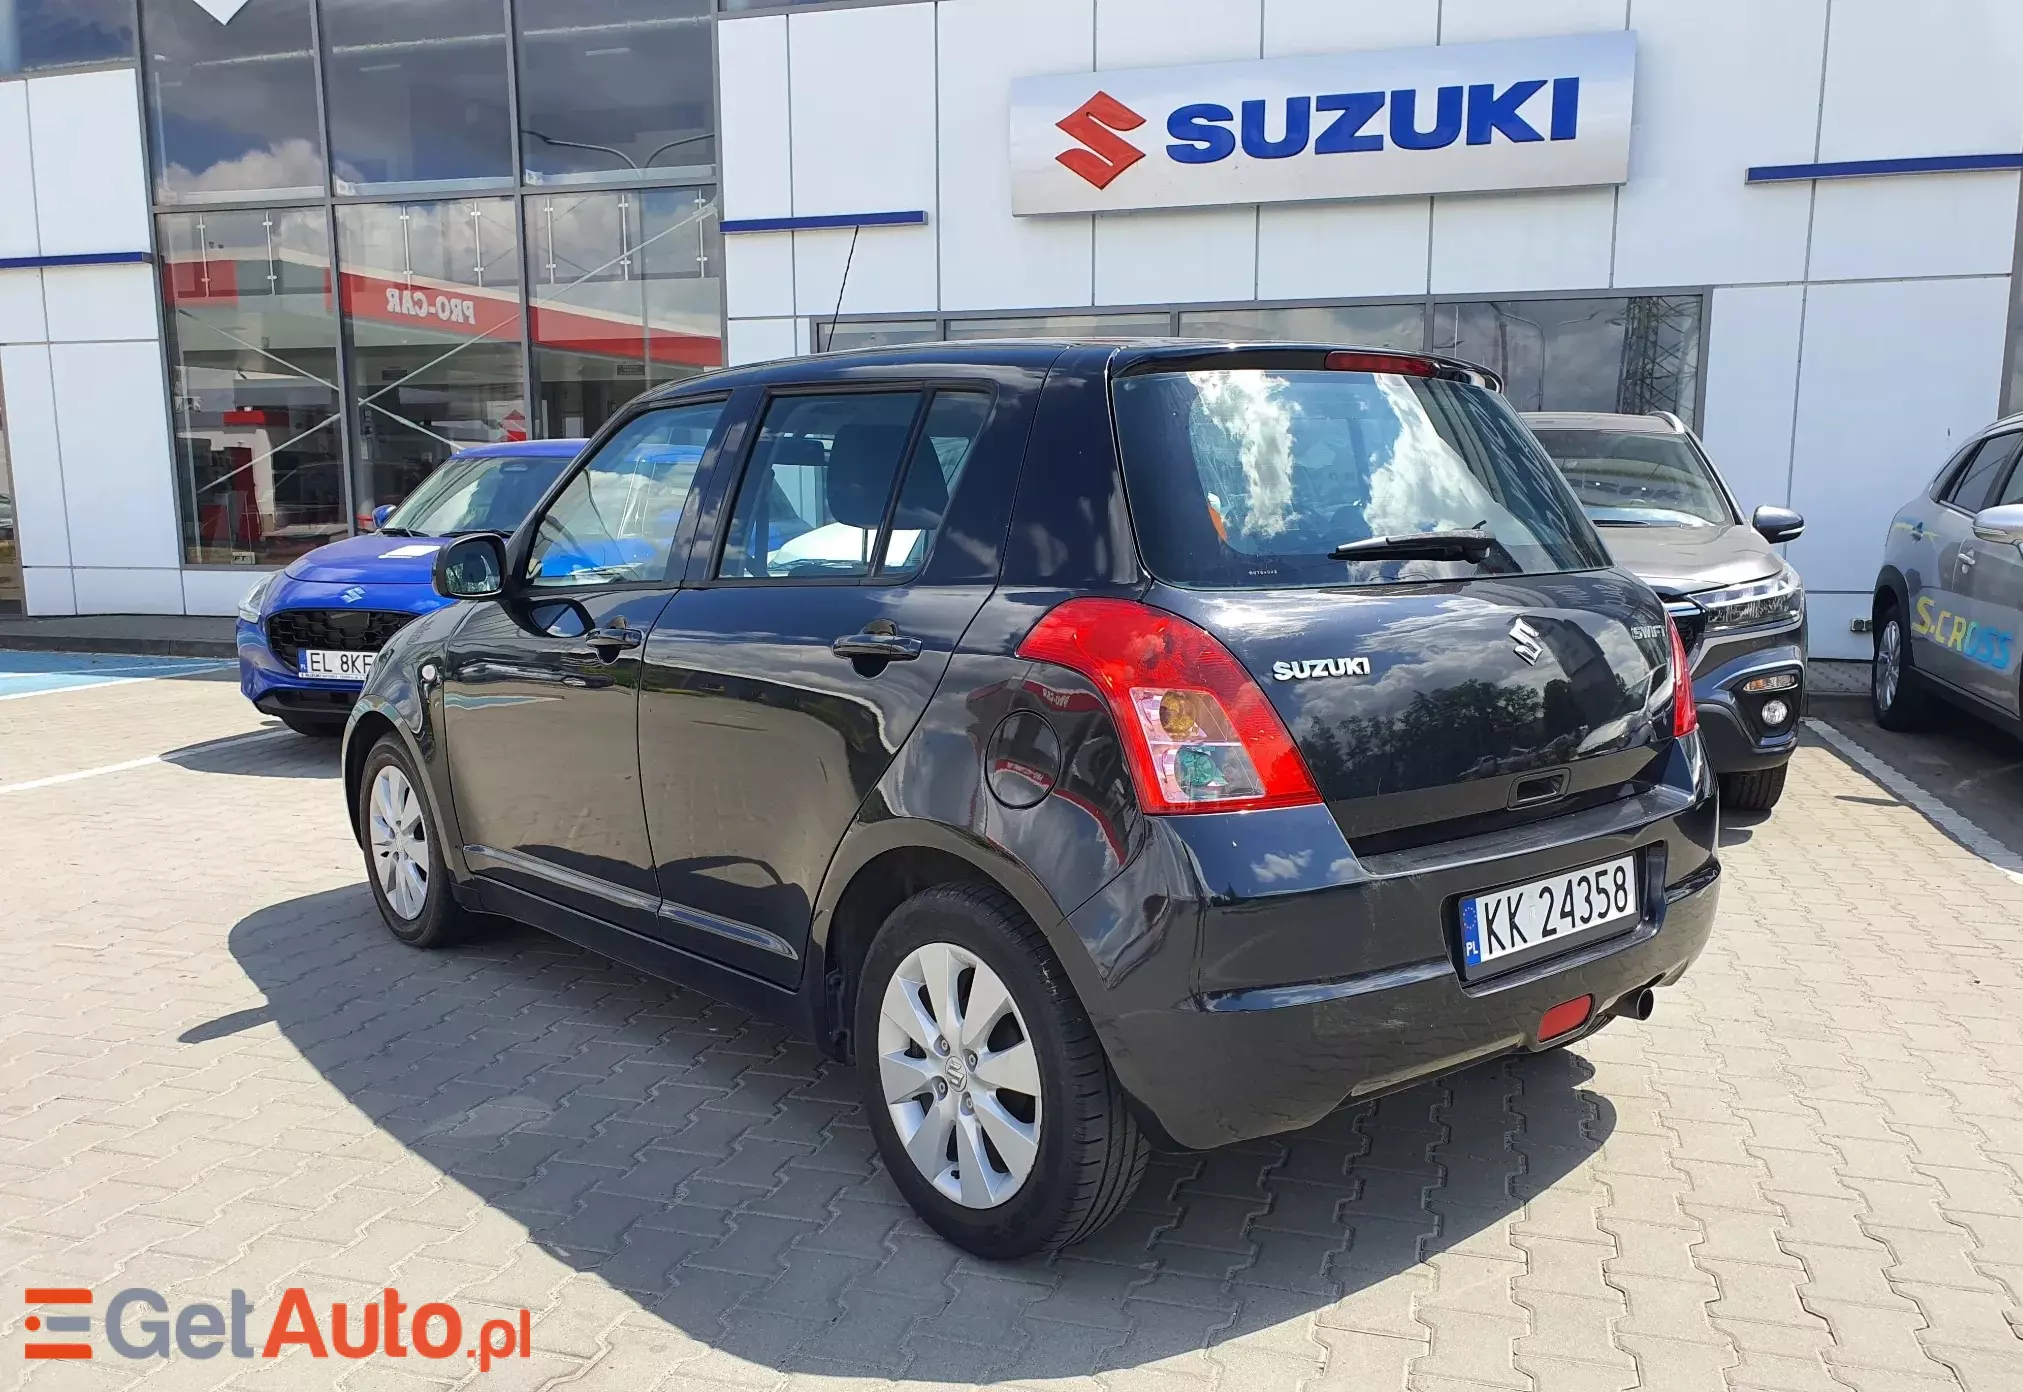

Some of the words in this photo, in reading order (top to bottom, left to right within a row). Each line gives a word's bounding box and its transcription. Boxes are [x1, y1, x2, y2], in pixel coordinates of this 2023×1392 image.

[1166, 76, 1580, 164] SUZUKI
[1631, 625, 1666, 640] SWIFT
[310, 652, 333, 673] EL
[1272, 657, 1370, 681] SUZUKI
[1484, 892, 1528, 955] KK
[1538, 865, 1628, 938] 24358
[1466, 941, 1479, 957] PL
